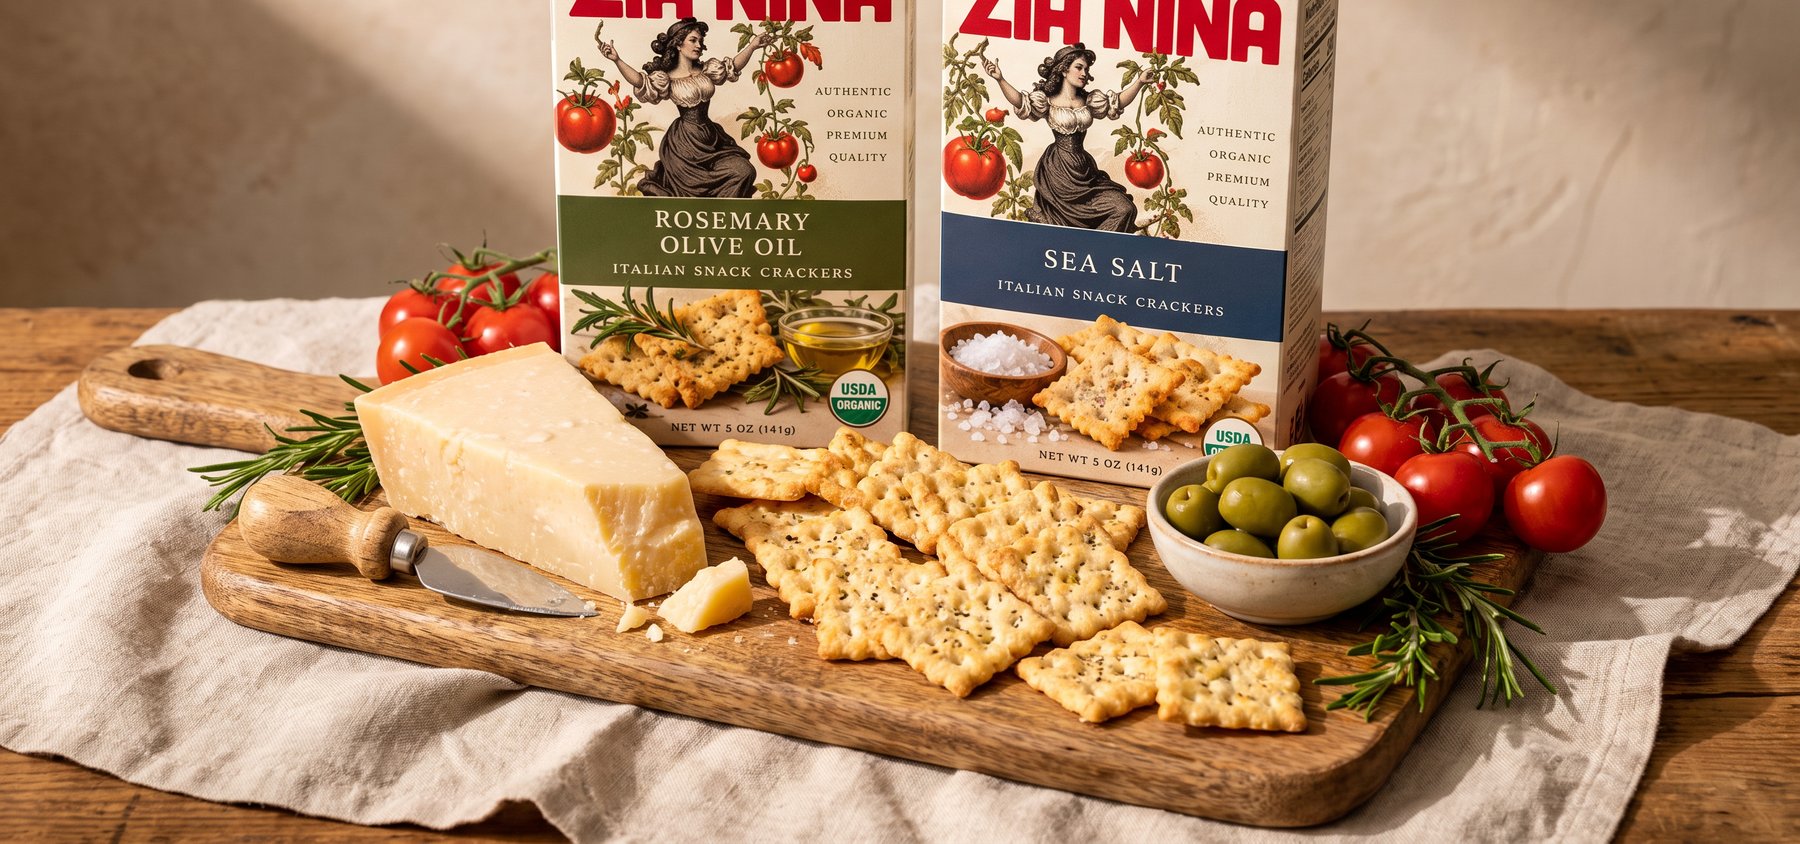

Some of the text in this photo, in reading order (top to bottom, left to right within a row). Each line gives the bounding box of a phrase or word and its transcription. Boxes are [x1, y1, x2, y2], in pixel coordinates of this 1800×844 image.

[1103, 0, 1281, 65] NINA
[815, 87, 892, 97] AUTHENTIC
[827, 109, 888, 119] ORGANIC
[826, 131, 888, 140] PREMIUM
[1197, 126, 1276, 142] AUTHENTIC
[829, 152, 888, 163] QUALITY
[1209, 149, 1271, 164] ORGANIC
[1207, 172, 1270, 187] PREMIUM
[1208, 194, 1269, 209] QUALITY
[655, 209, 810, 231] ROSEMARY
[660, 235, 802, 257] OLIVE OIL
[613, 263, 853, 280] ITALIAN SNACK CRACKERS
[1044, 249, 1182, 283] SEA SALT
[998, 279, 1225, 318] ITALIAN SNACK CRACKERS
[841, 383, 877, 396] USDA
[836, 400, 882, 411] ORGANIC
[671, 422, 797, 436] NET WT 5 OZ (141g)
[1216, 429, 1251, 445] USDA
[1039, 450, 1163, 476] NET WT 5 OZ (141g)
